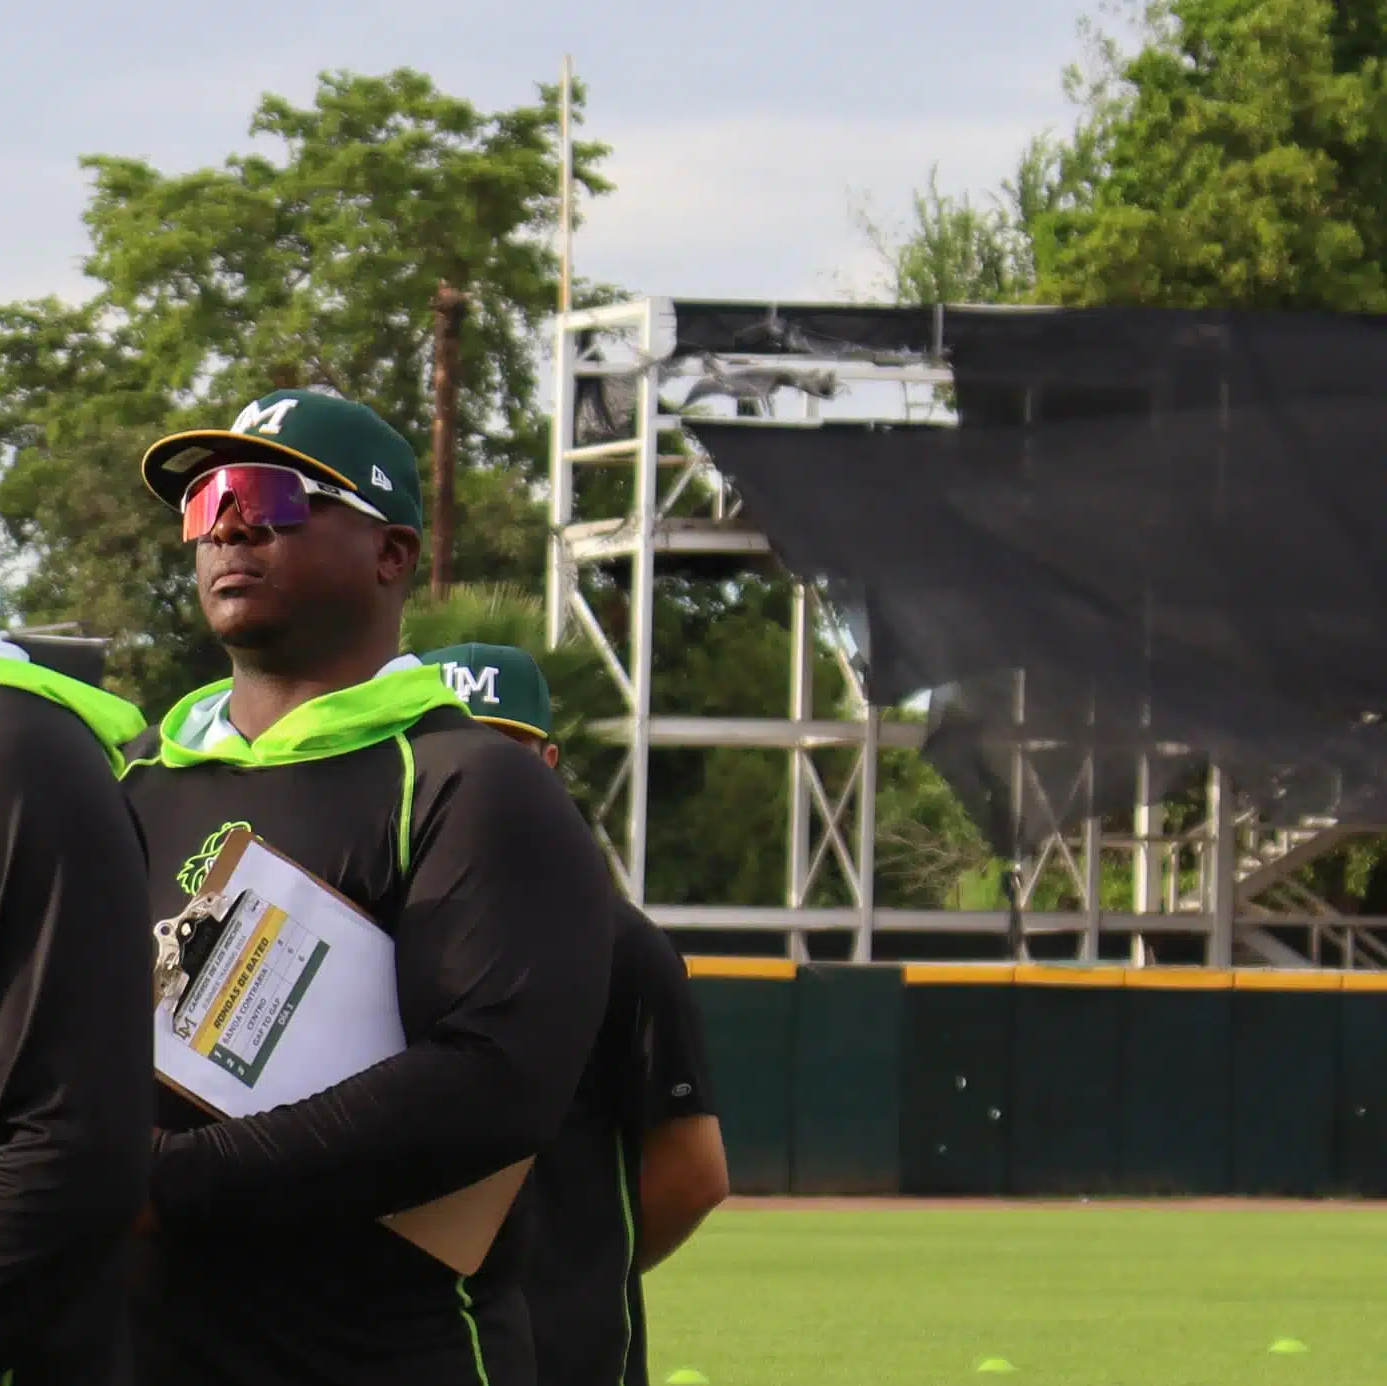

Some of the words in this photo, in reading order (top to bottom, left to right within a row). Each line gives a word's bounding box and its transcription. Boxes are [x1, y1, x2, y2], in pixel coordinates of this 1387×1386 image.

[212, 986, 241, 1029] RONDAS
[236, 972, 250, 987] DE
[244, 936, 270, 973] BATEO
[238, 967, 270, 1014] CONTRARIA
[245, 997, 268, 1031] CENTRO
